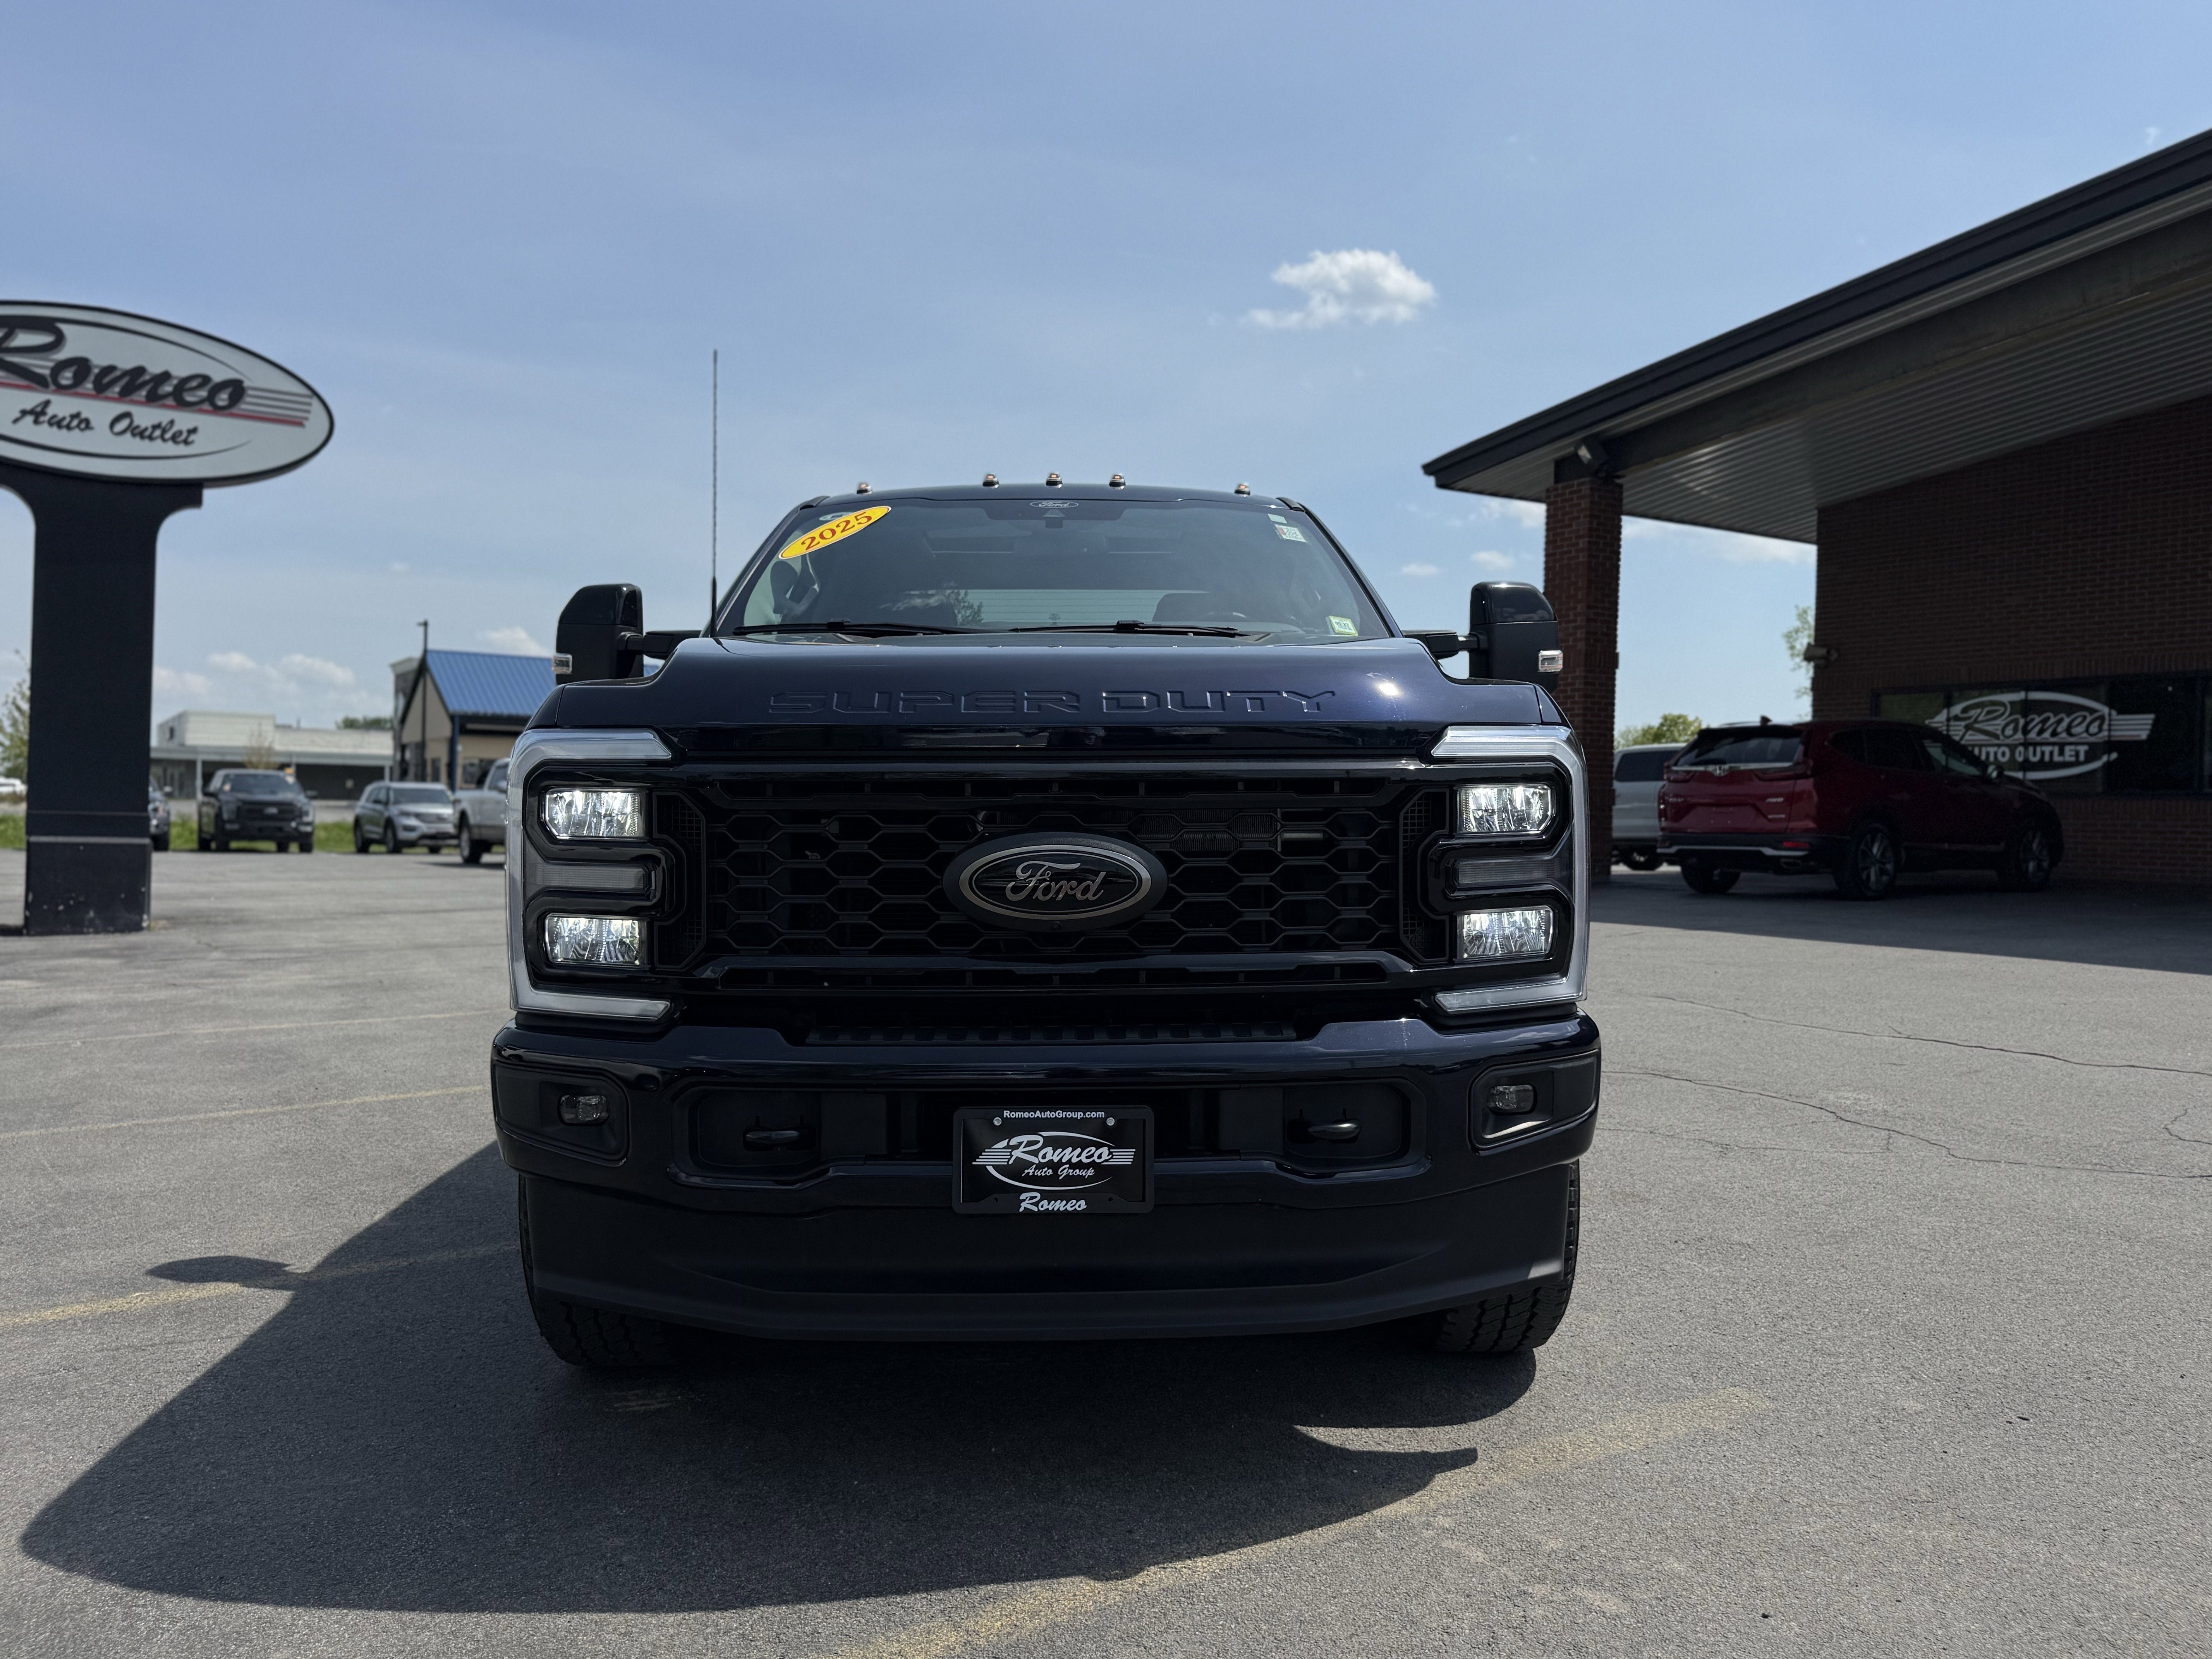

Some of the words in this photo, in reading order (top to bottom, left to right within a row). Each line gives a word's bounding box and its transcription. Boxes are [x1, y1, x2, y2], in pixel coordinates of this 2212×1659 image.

[12, 398, 94, 432] Auto
[109, 411, 199, 446] Outlet
[801, 512, 872, 551] 2025
[769, 691, 1080, 713] SUPER
[1102, 690, 1336, 713] DUTY
[1953, 699, 2106, 742] Romeo
[1968, 745, 2010, 762] UTO
[2015, 745, 2089, 762] OUTLET
[1005, 861, 1106, 901] Ford
[1003, 1110, 1105, 1119] RomeoAutoGroup.com
[1009, 1135, 1112, 1164] Romeo
[1022, 1164, 1053, 1177] Auto
[1058, 1164, 1095, 1180] Group
[1019, 1192, 1087, 1212] Romeo
